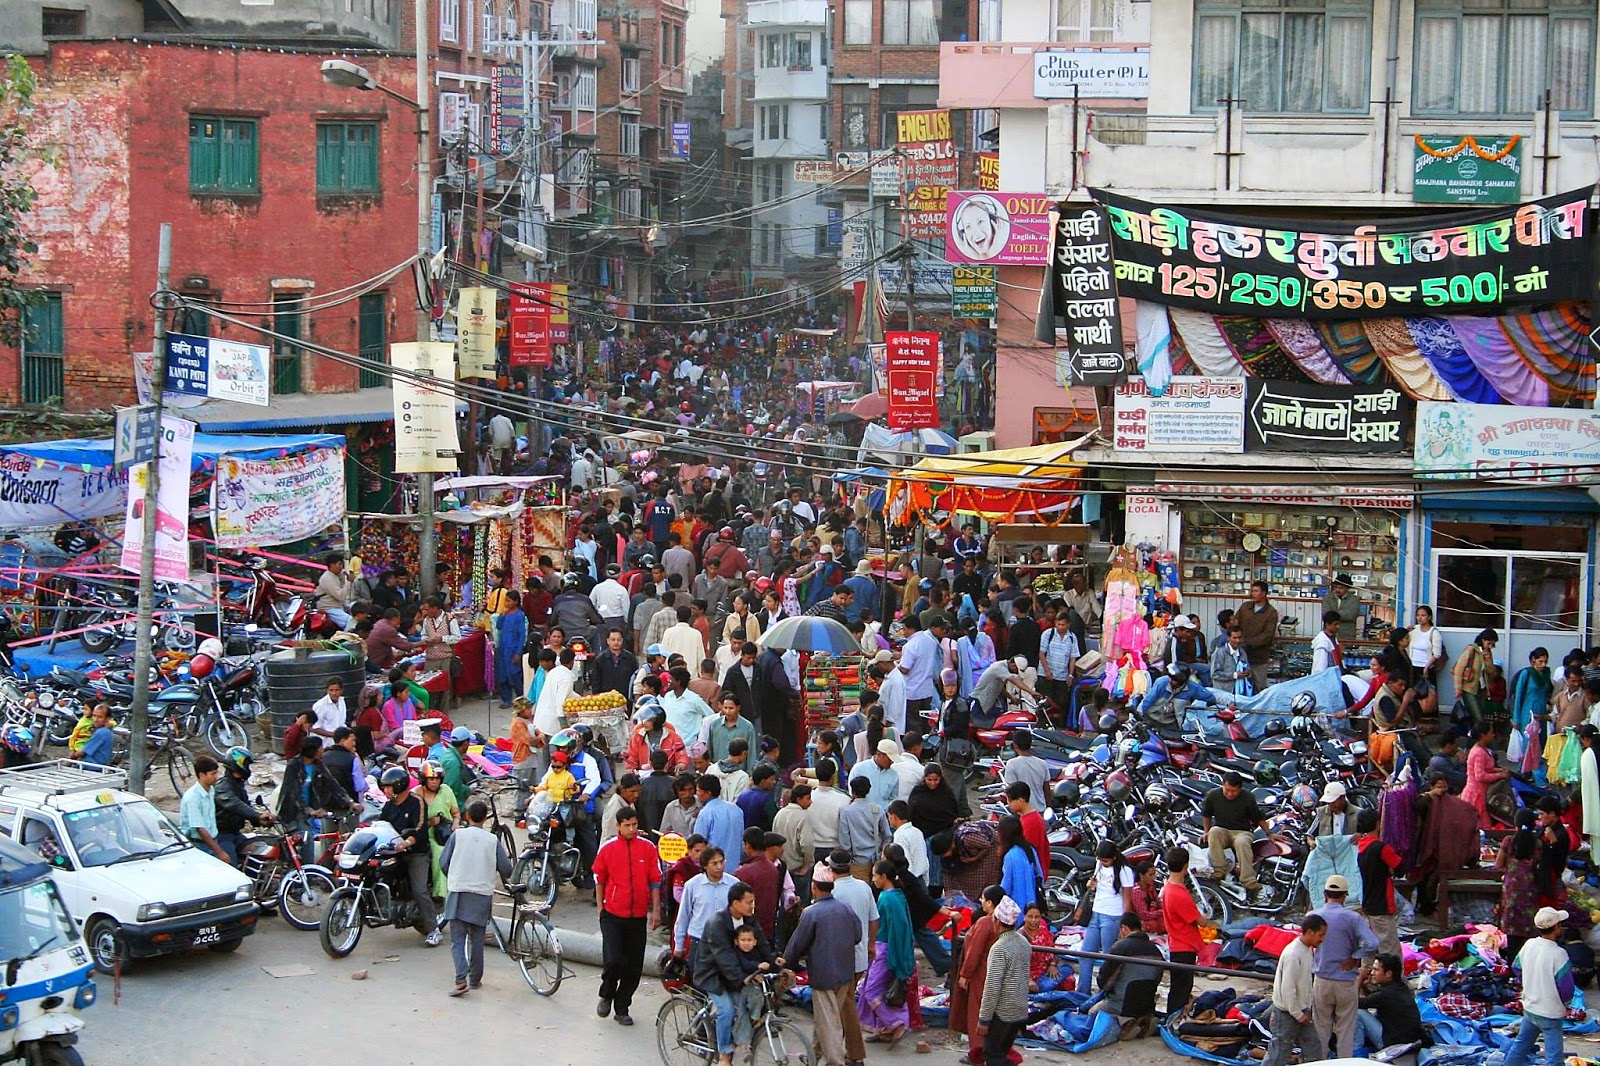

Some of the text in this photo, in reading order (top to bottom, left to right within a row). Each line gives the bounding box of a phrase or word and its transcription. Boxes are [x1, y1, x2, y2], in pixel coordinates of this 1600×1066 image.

[1049, 55, 1079, 69] Plus
[1038, 65, 1115, 81] Computer
[1446, 187, 1476, 195] SANSTHA
[1006, 197, 1048, 215] OSIZ
[1058, 209, 1102, 242] साड़ी
[1012, 233, 1038, 241] English,
[1057, 240, 1110, 266] संसार
[1114, 259, 1155, 285] मात्र
[1060, 266, 1110, 296] पहिलो
[1066, 298, 1115, 319] तल्ला
[554, 330, 566, 338] LG
[1073, 322, 1114, 345] माथी
[169, 365, 206, 382] KANTI PATH
[230, 381, 255, 394] Orbit
[1353, 388, 1401, 415] साड़ी
[1261, 400, 1303, 429] जाने
[1303, 402, 1348, 431] बाटो
[1350, 417, 1401, 442] संसार
[1129, 496, 1156, 504] ISD
[1339, 498, 1412, 508] RIPARING
[1128, 505, 1161, 514] LOCAL
